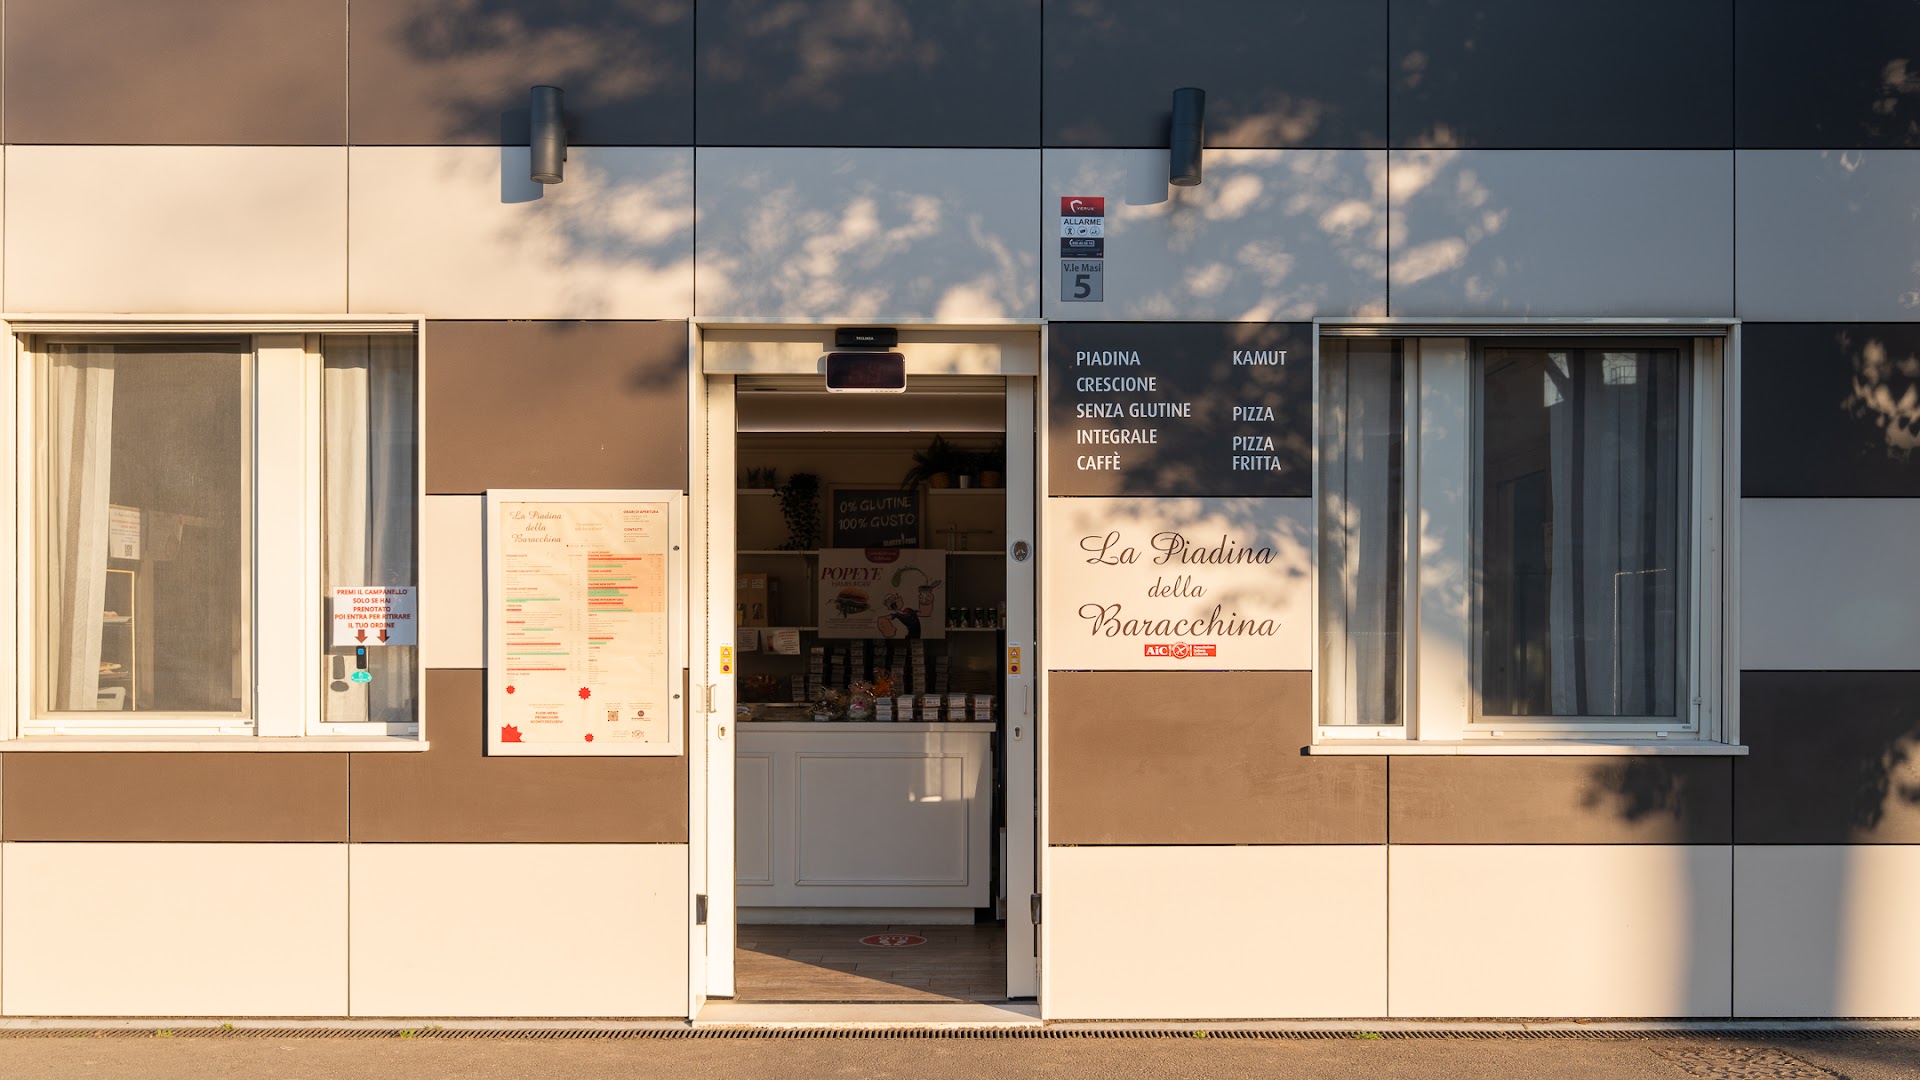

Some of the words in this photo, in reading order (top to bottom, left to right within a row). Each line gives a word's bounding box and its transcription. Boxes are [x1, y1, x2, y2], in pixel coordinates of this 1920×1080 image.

[1064, 264, 1080, 272] V.le
[1082, 264, 1100, 272] Masi
[1074, 274, 1091, 299] 5
[1076, 351, 1141, 366] PIADINA
[1232, 350, 1287, 365] KAMUT
[1076, 377, 1156, 392] CRESCIONE
[1076, 403, 1124, 418] SENZA
[1129, 402, 1191, 418] GLUTINE
[1232, 406, 1274, 421] PIZZA
[1076, 429, 1158, 444] INTEGRALE
[1232, 436, 1274, 451] PIZZA
[1076, 452, 1121, 471] CAFFÈ
[1232, 456, 1282, 471] FRITTA
[840, 501, 858, 513] 0%
[859, 496, 911, 512] GLUTINE
[510, 511, 526, 519] La
[529, 511, 562, 519] Piadina
[838, 518, 868, 530] 100%
[870, 514, 916, 528] GUSTO
[526, 522, 546, 531] della
[512, 534, 561, 542] Baracchina
[1080, 531, 1142, 565] La
[1151, 532, 1278, 565] Piadina
[821, 567, 883, 580] POPEYE
[1148, 574, 1207, 598] della
[1078, 603, 1282, 637] Baracchina
